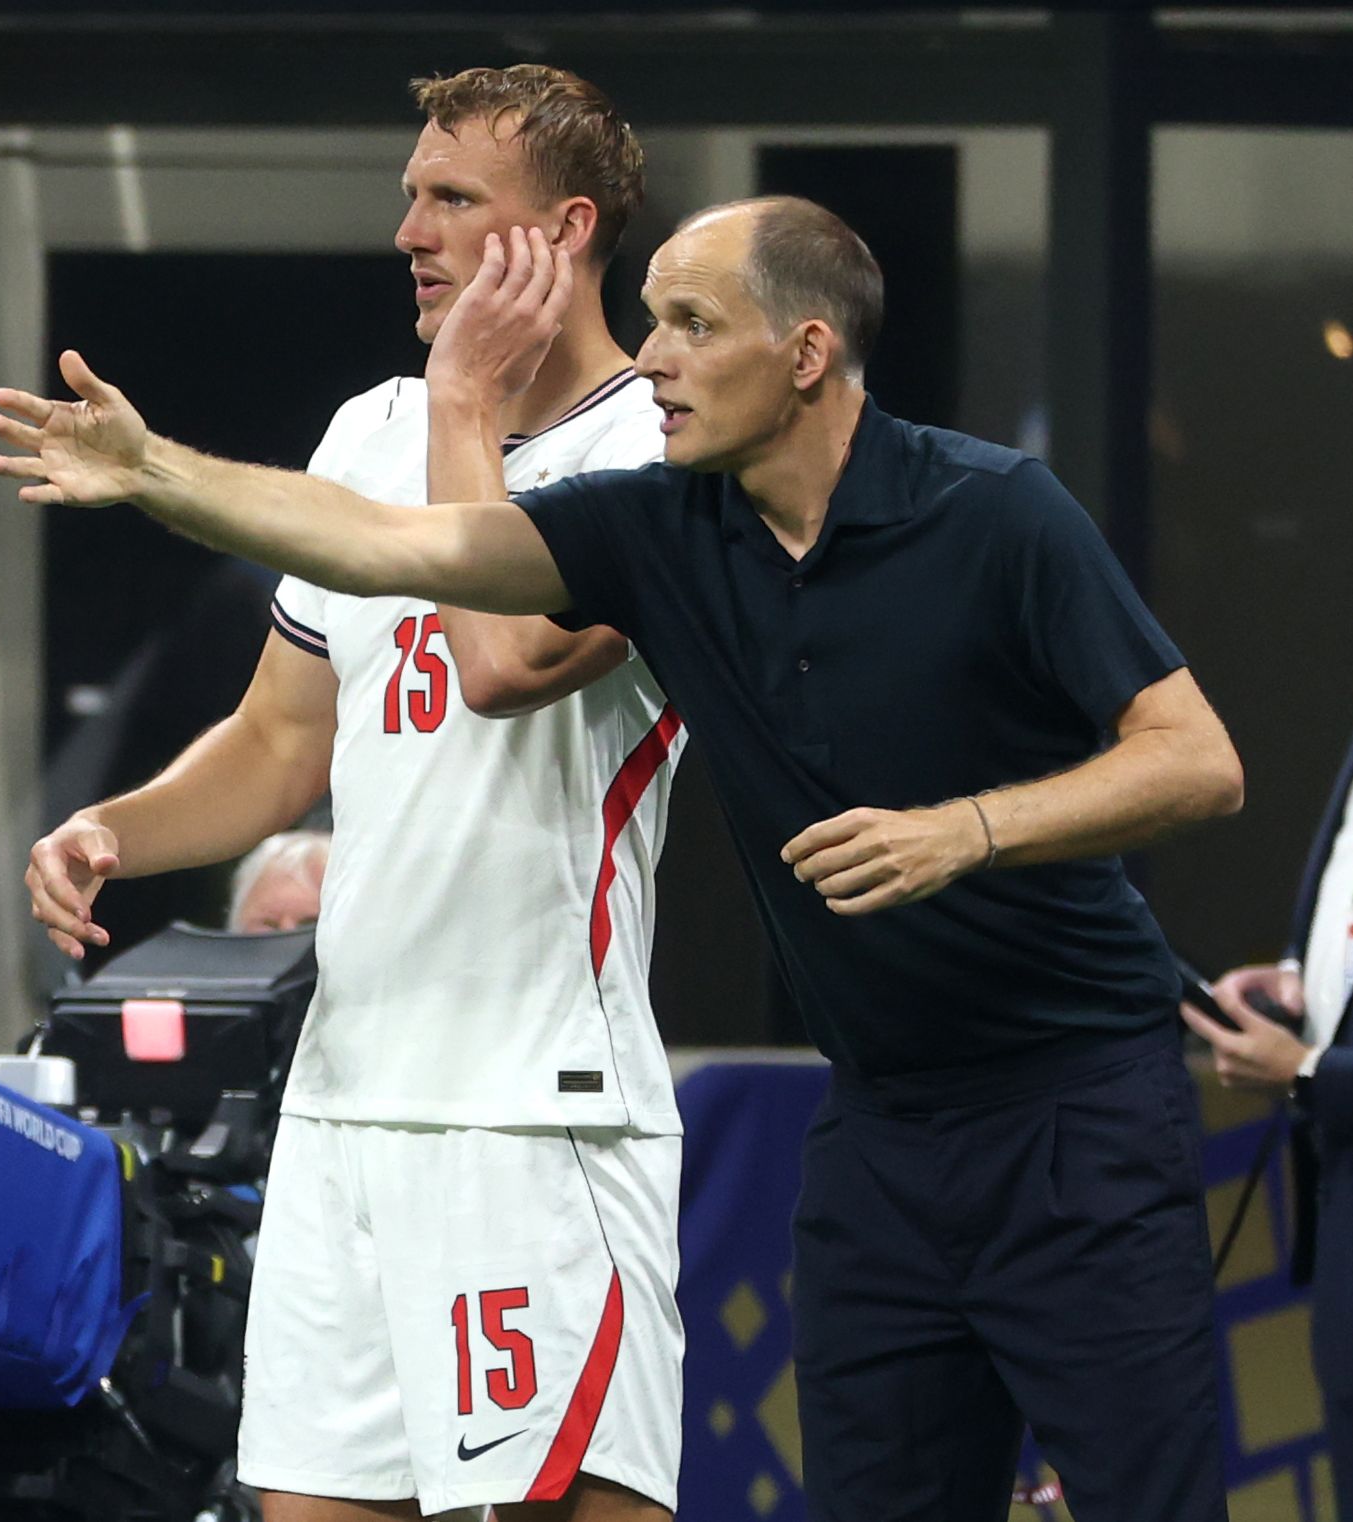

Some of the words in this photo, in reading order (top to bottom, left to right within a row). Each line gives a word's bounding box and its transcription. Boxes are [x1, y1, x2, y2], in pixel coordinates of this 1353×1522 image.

[383, 613, 448, 734] 15
[13, 1105, 56, 1151] WORLD
[55, 1127, 84, 1162] CUP
[451, 1286, 538, 1416] 15
